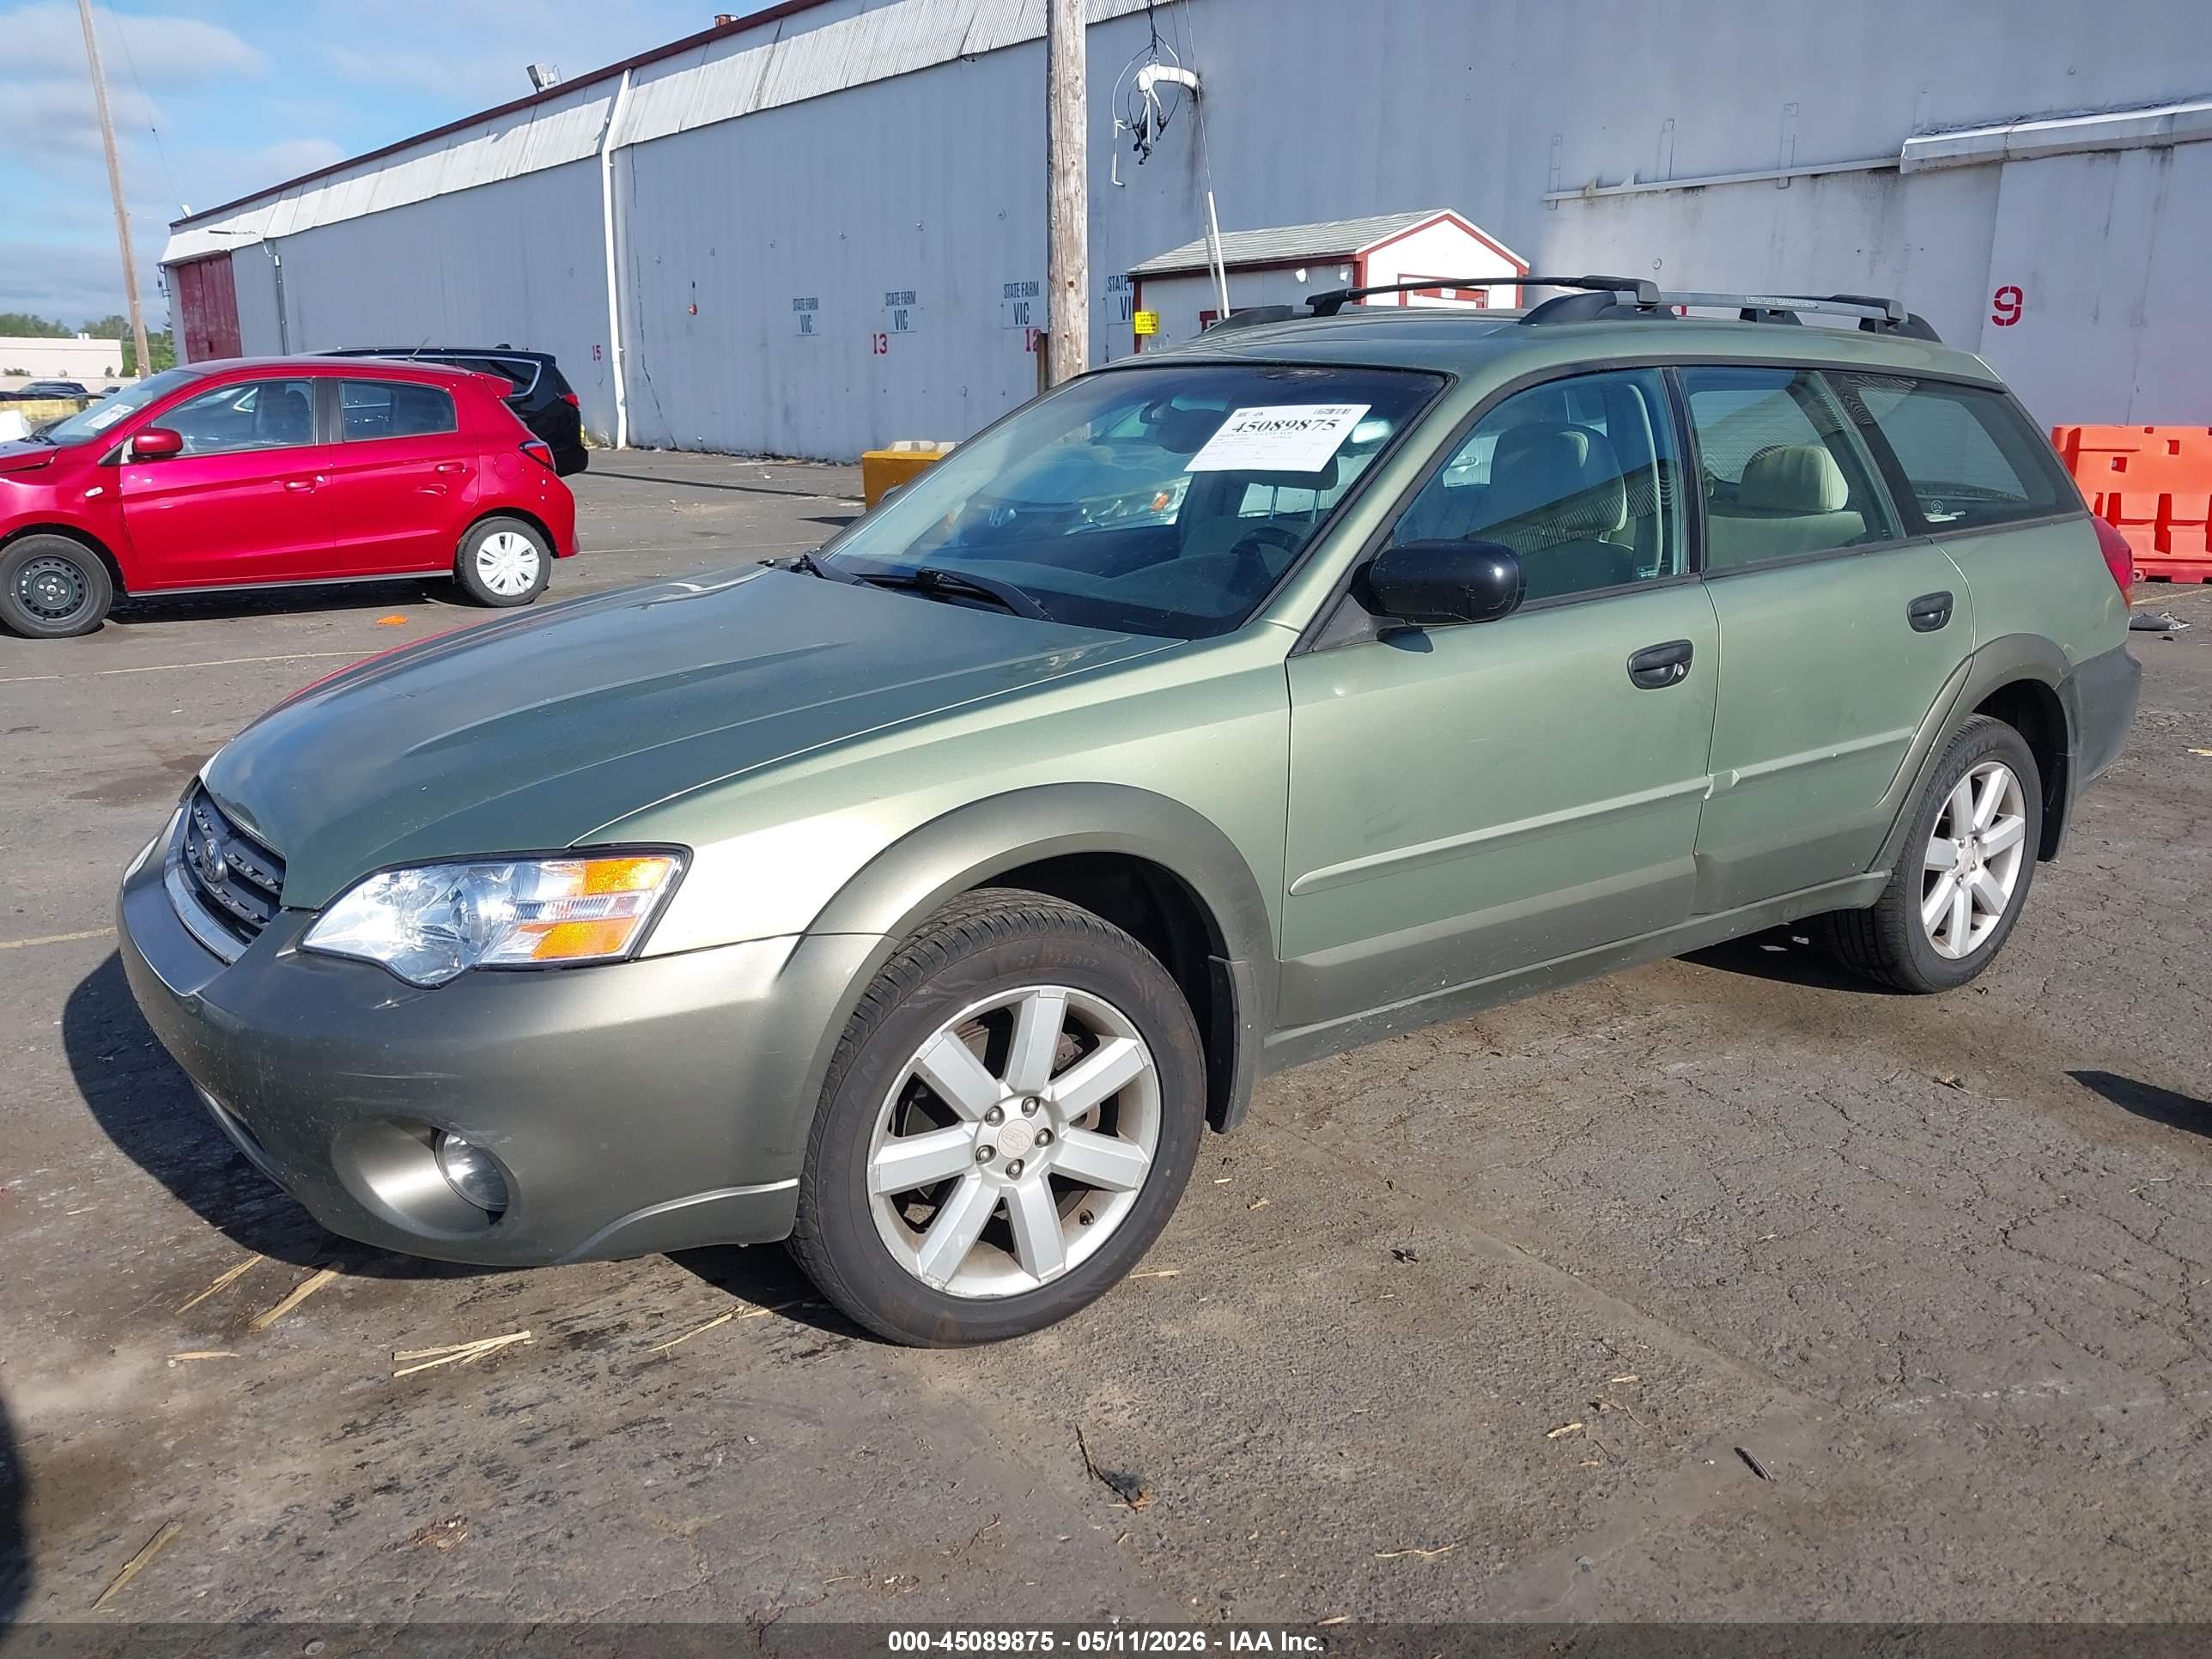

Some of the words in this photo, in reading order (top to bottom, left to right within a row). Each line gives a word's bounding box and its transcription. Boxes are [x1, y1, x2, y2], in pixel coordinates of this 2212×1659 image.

[1004, 283, 1020, 299] STATE
[1021, 281, 1039, 297] FARM
[1108, 275, 1127, 292] STATE
[793, 298, 805, 312] STATE
[805, 297, 819, 310] FARM
[885, 292, 901, 307] STATE
[901, 290, 916, 305] FARM
[1120, 295, 1132, 320] VI
[1991, 286, 2023, 326] 9
[894, 309, 908, 331] VIC
[1013, 301, 1030, 325] VIC
[799, 314, 812, 333] VIC
[592, 344, 602, 362] 15
[872, 333, 888, 355] 13
[1231, 418, 1340, 433] 45089875
